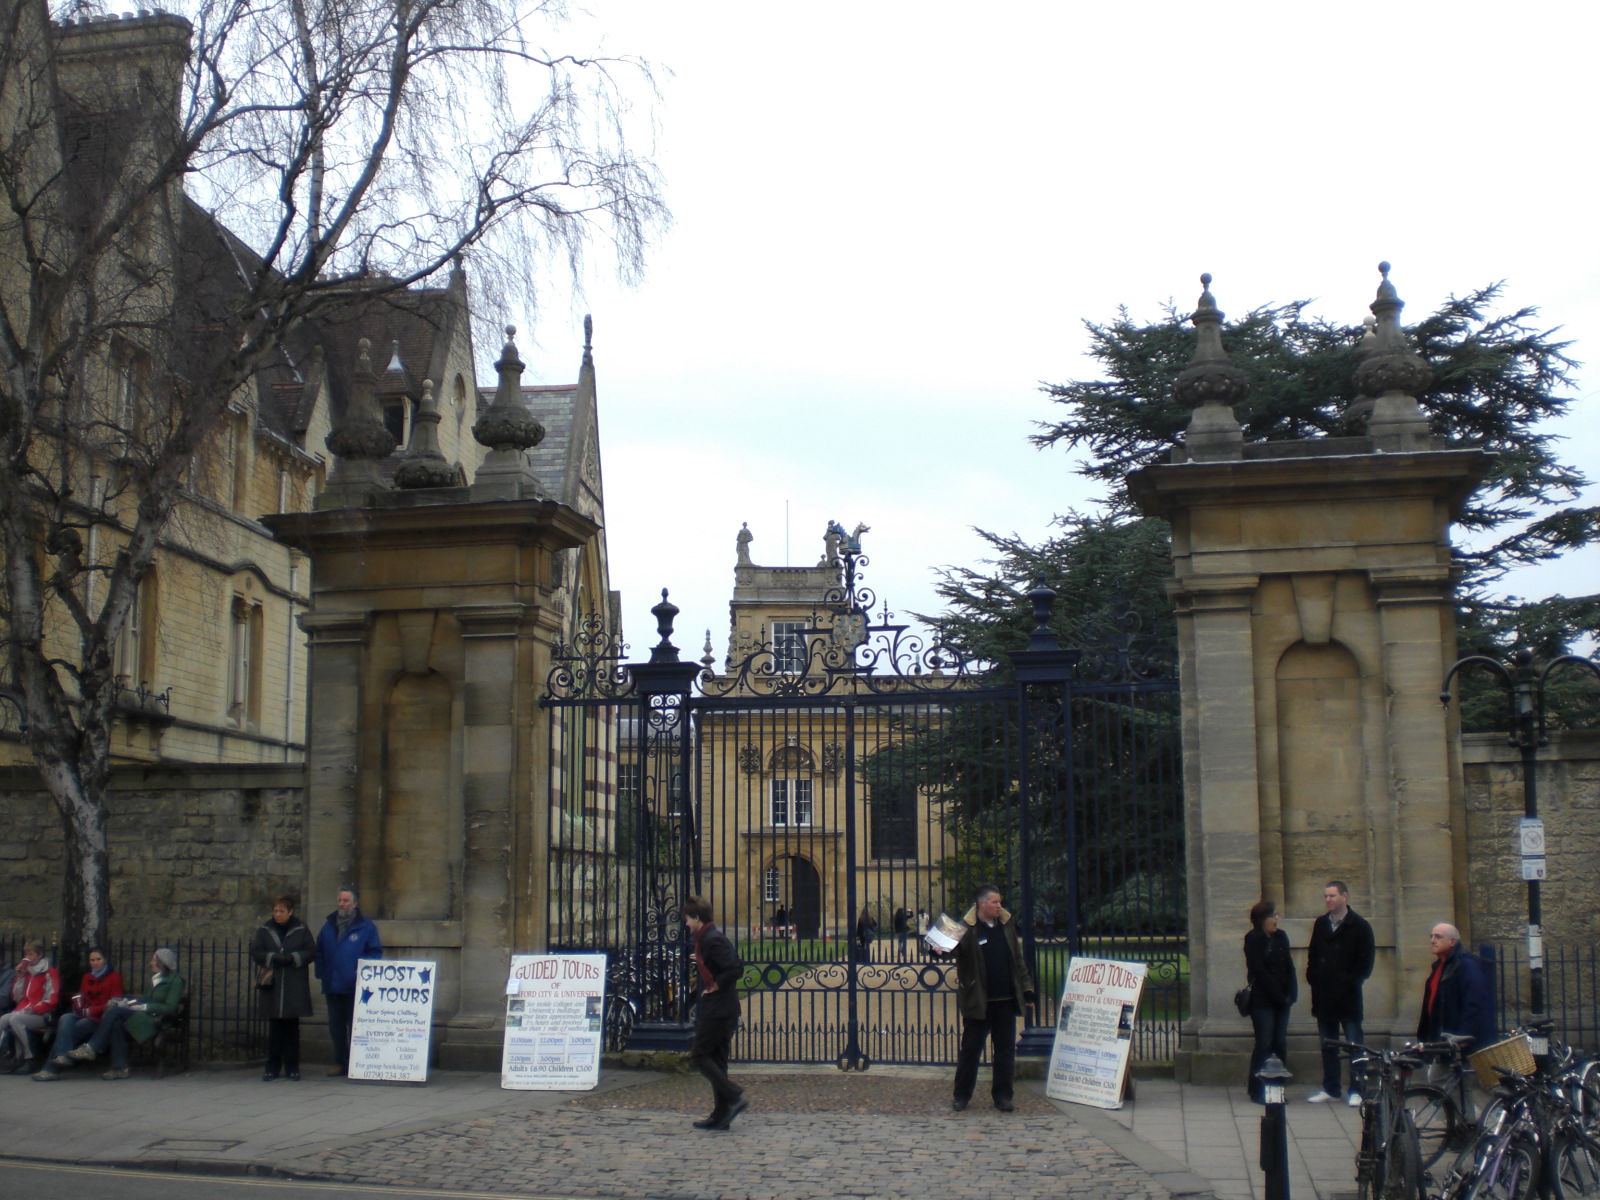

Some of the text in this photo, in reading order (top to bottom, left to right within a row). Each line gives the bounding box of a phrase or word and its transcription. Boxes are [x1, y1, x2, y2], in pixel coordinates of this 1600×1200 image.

[361, 965, 416, 982] GHOST
[515, 959, 599, 979] GUIDED TOURS
[1071, 963, 1138, 989] GUIDED TOURS
[378, 987, 430, 1004] TOURS
[538, 990, 552, 998] CITY
[554, 990, 559, 998] &
[1085, 994, 1097, 1003] CITY
